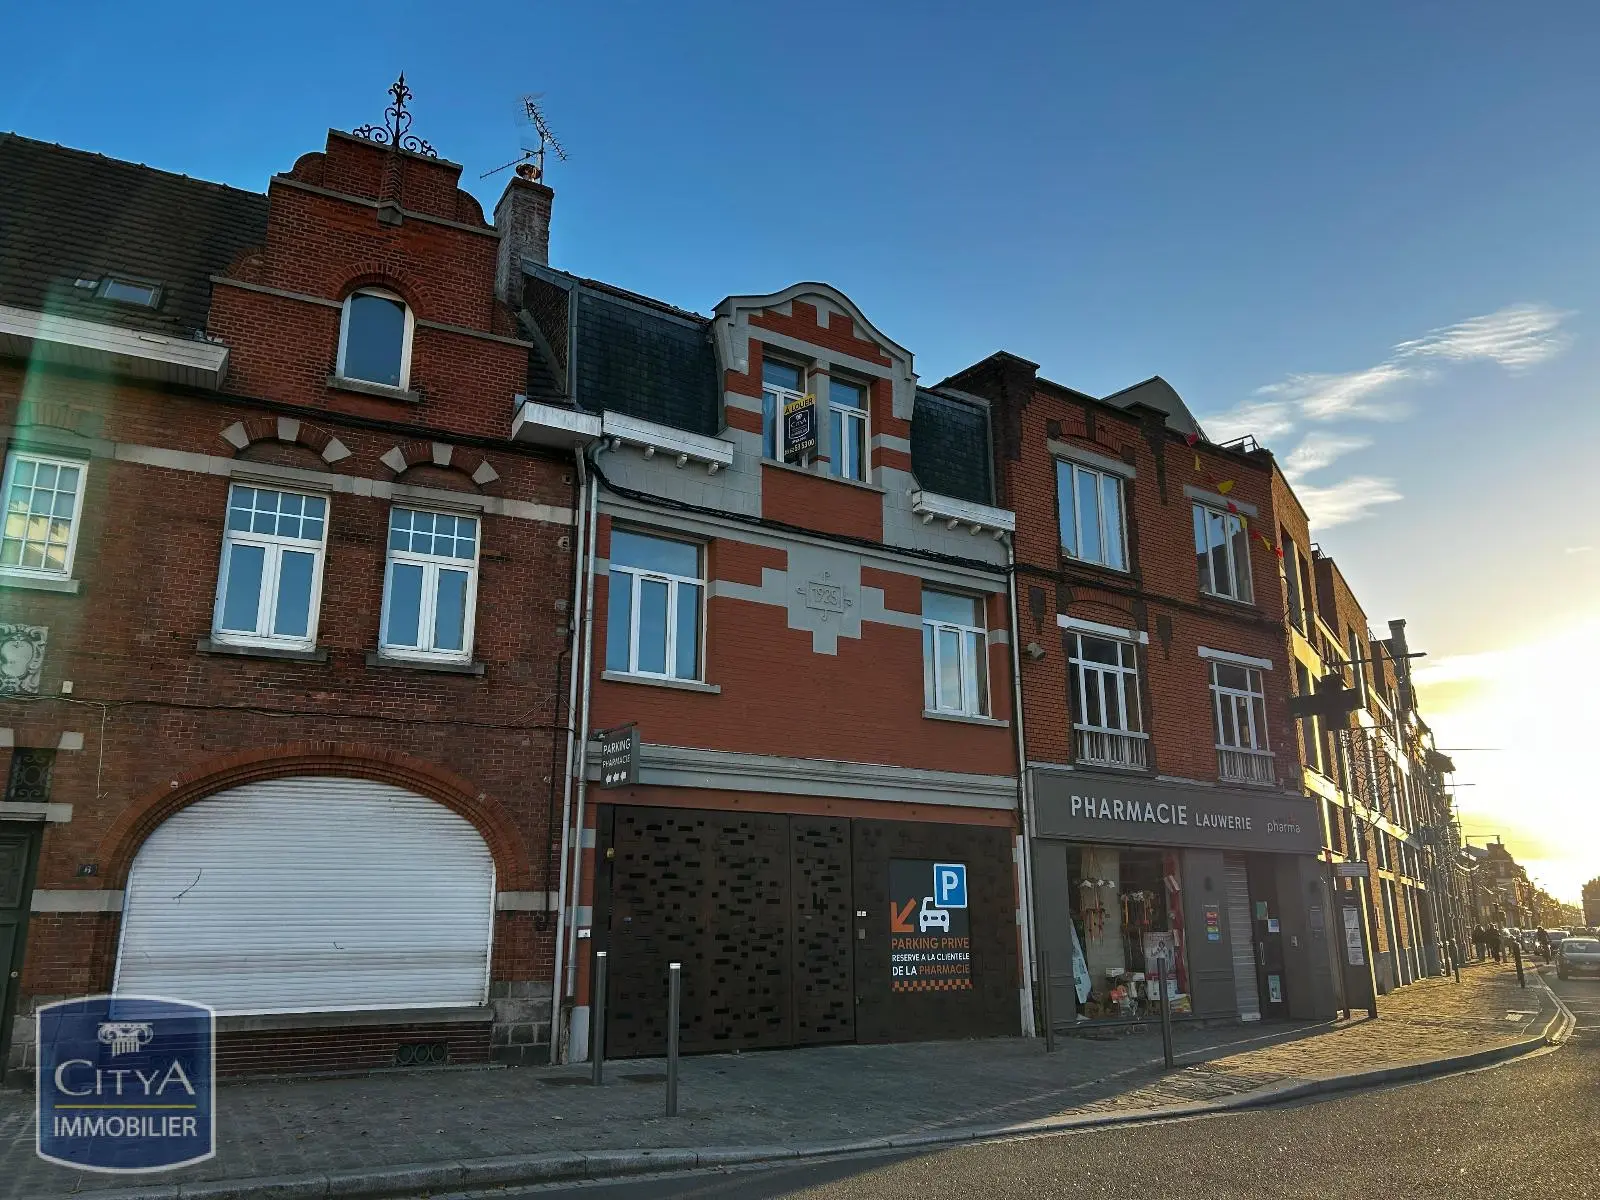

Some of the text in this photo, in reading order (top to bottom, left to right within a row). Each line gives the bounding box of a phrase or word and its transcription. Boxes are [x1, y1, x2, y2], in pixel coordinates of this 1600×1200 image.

[792, 398, 813, 412] LOUER
[603, 737, 631, 756] PARKING
[1070, 795, 1188, 826] PHARMACIE
[1195, 812, 1252, 831] LAUWERIE
[941, 870, 959, 901] P
[891, 938, 939, 951] PARKING
[927, 953, 936, 962] LA
[892, 964, 971, 976] DE LA PHARMACIE
